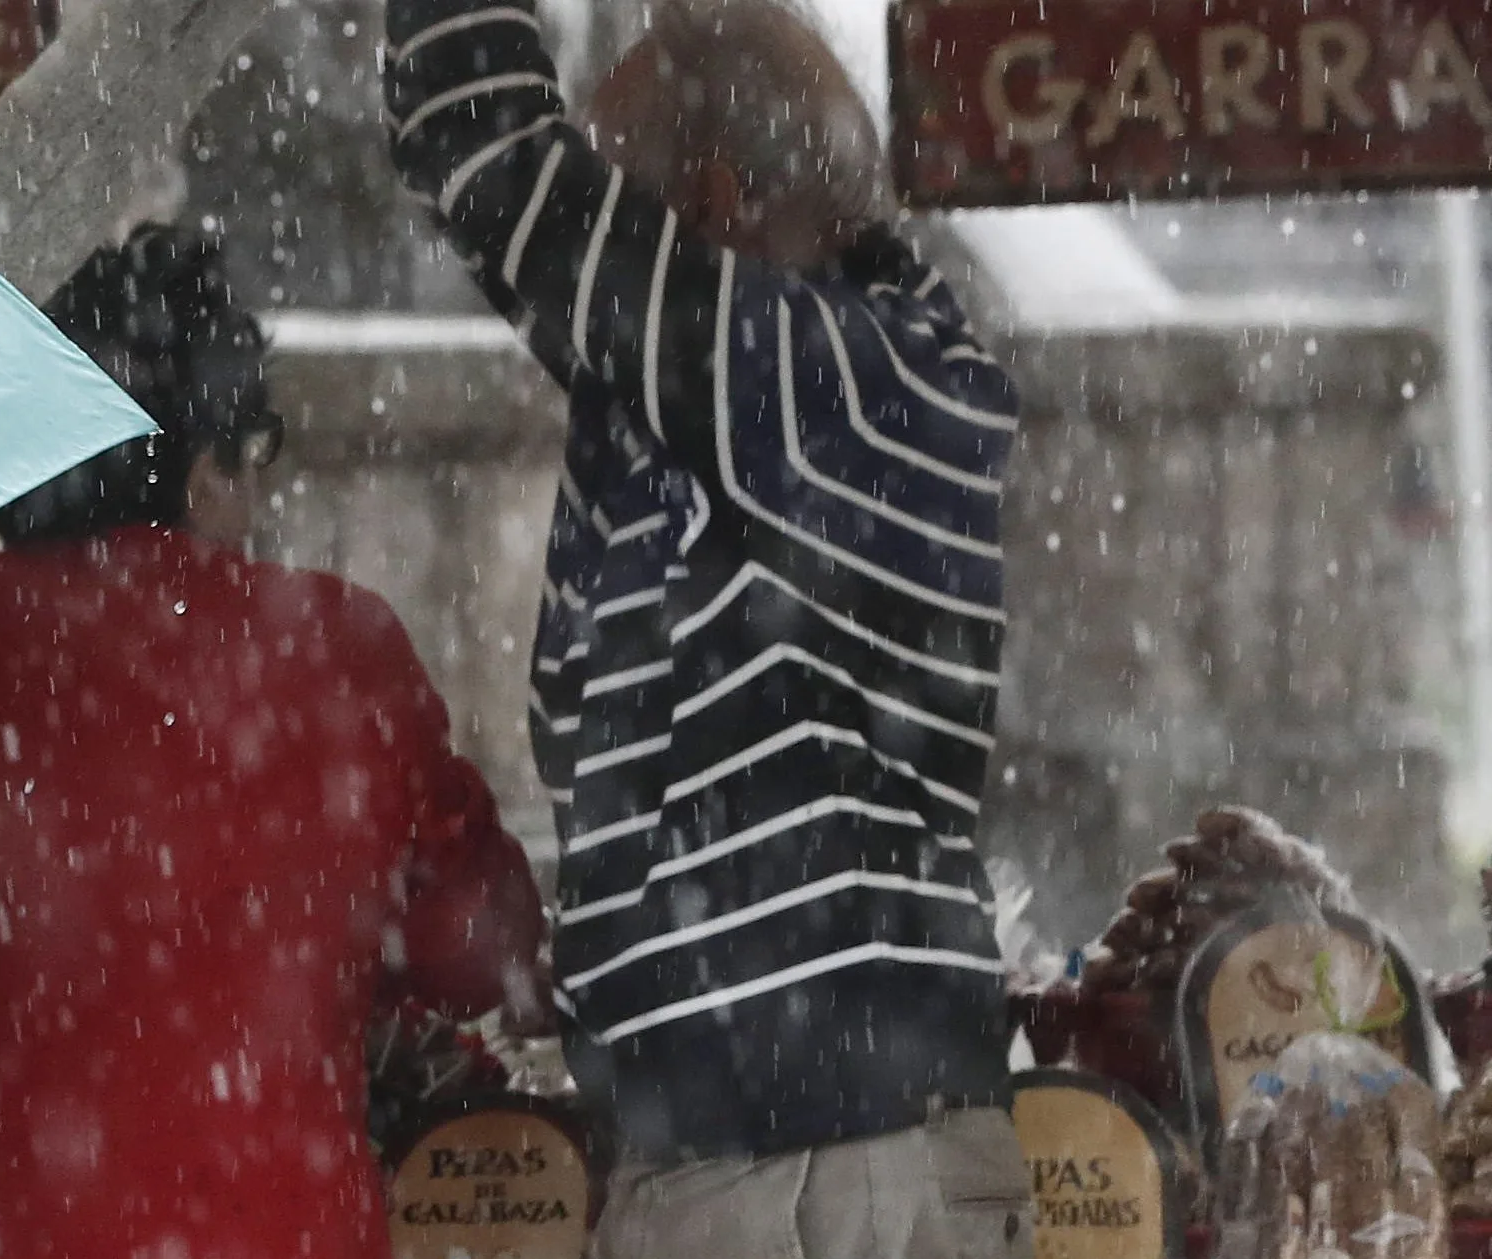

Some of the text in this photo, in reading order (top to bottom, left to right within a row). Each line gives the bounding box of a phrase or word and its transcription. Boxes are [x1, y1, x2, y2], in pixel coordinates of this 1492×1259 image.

[981, 15, 1492, 146] GARRA
[474, 1181, 507, 1199] DE
[1027, 1156, 1115, 1194] PAS
[401, 1199, 569, 1225] CALABAZA
